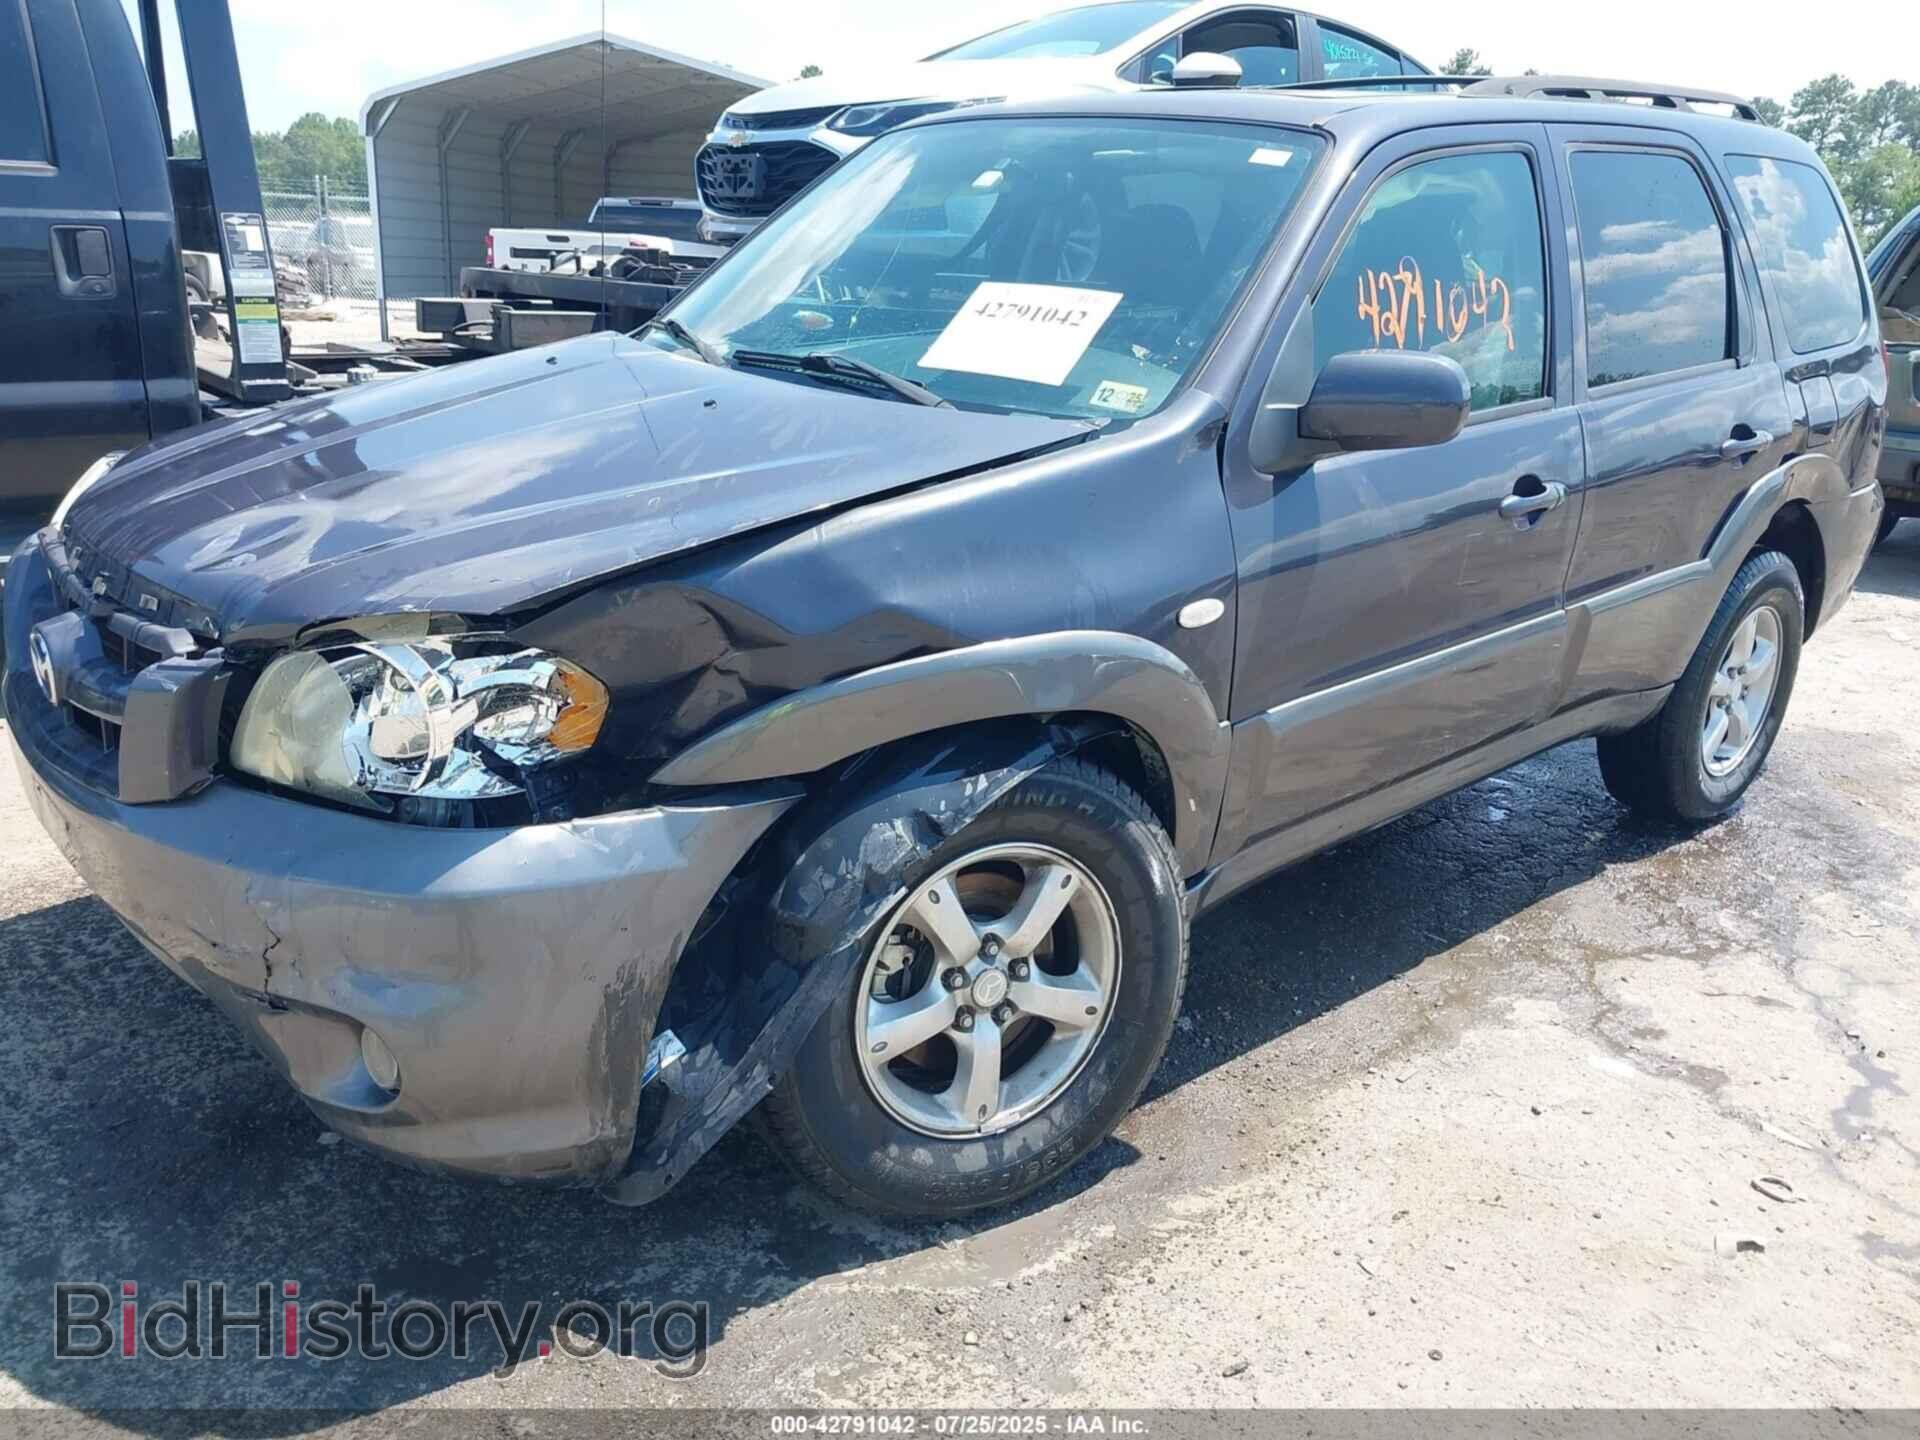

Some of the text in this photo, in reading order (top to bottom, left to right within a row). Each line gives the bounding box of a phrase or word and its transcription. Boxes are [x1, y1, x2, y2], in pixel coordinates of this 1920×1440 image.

[975, 301, 1088, 327] 42791042
[1358, 255, 1514, 351] 42791042
[1097, 387, 1115, 402] 12
